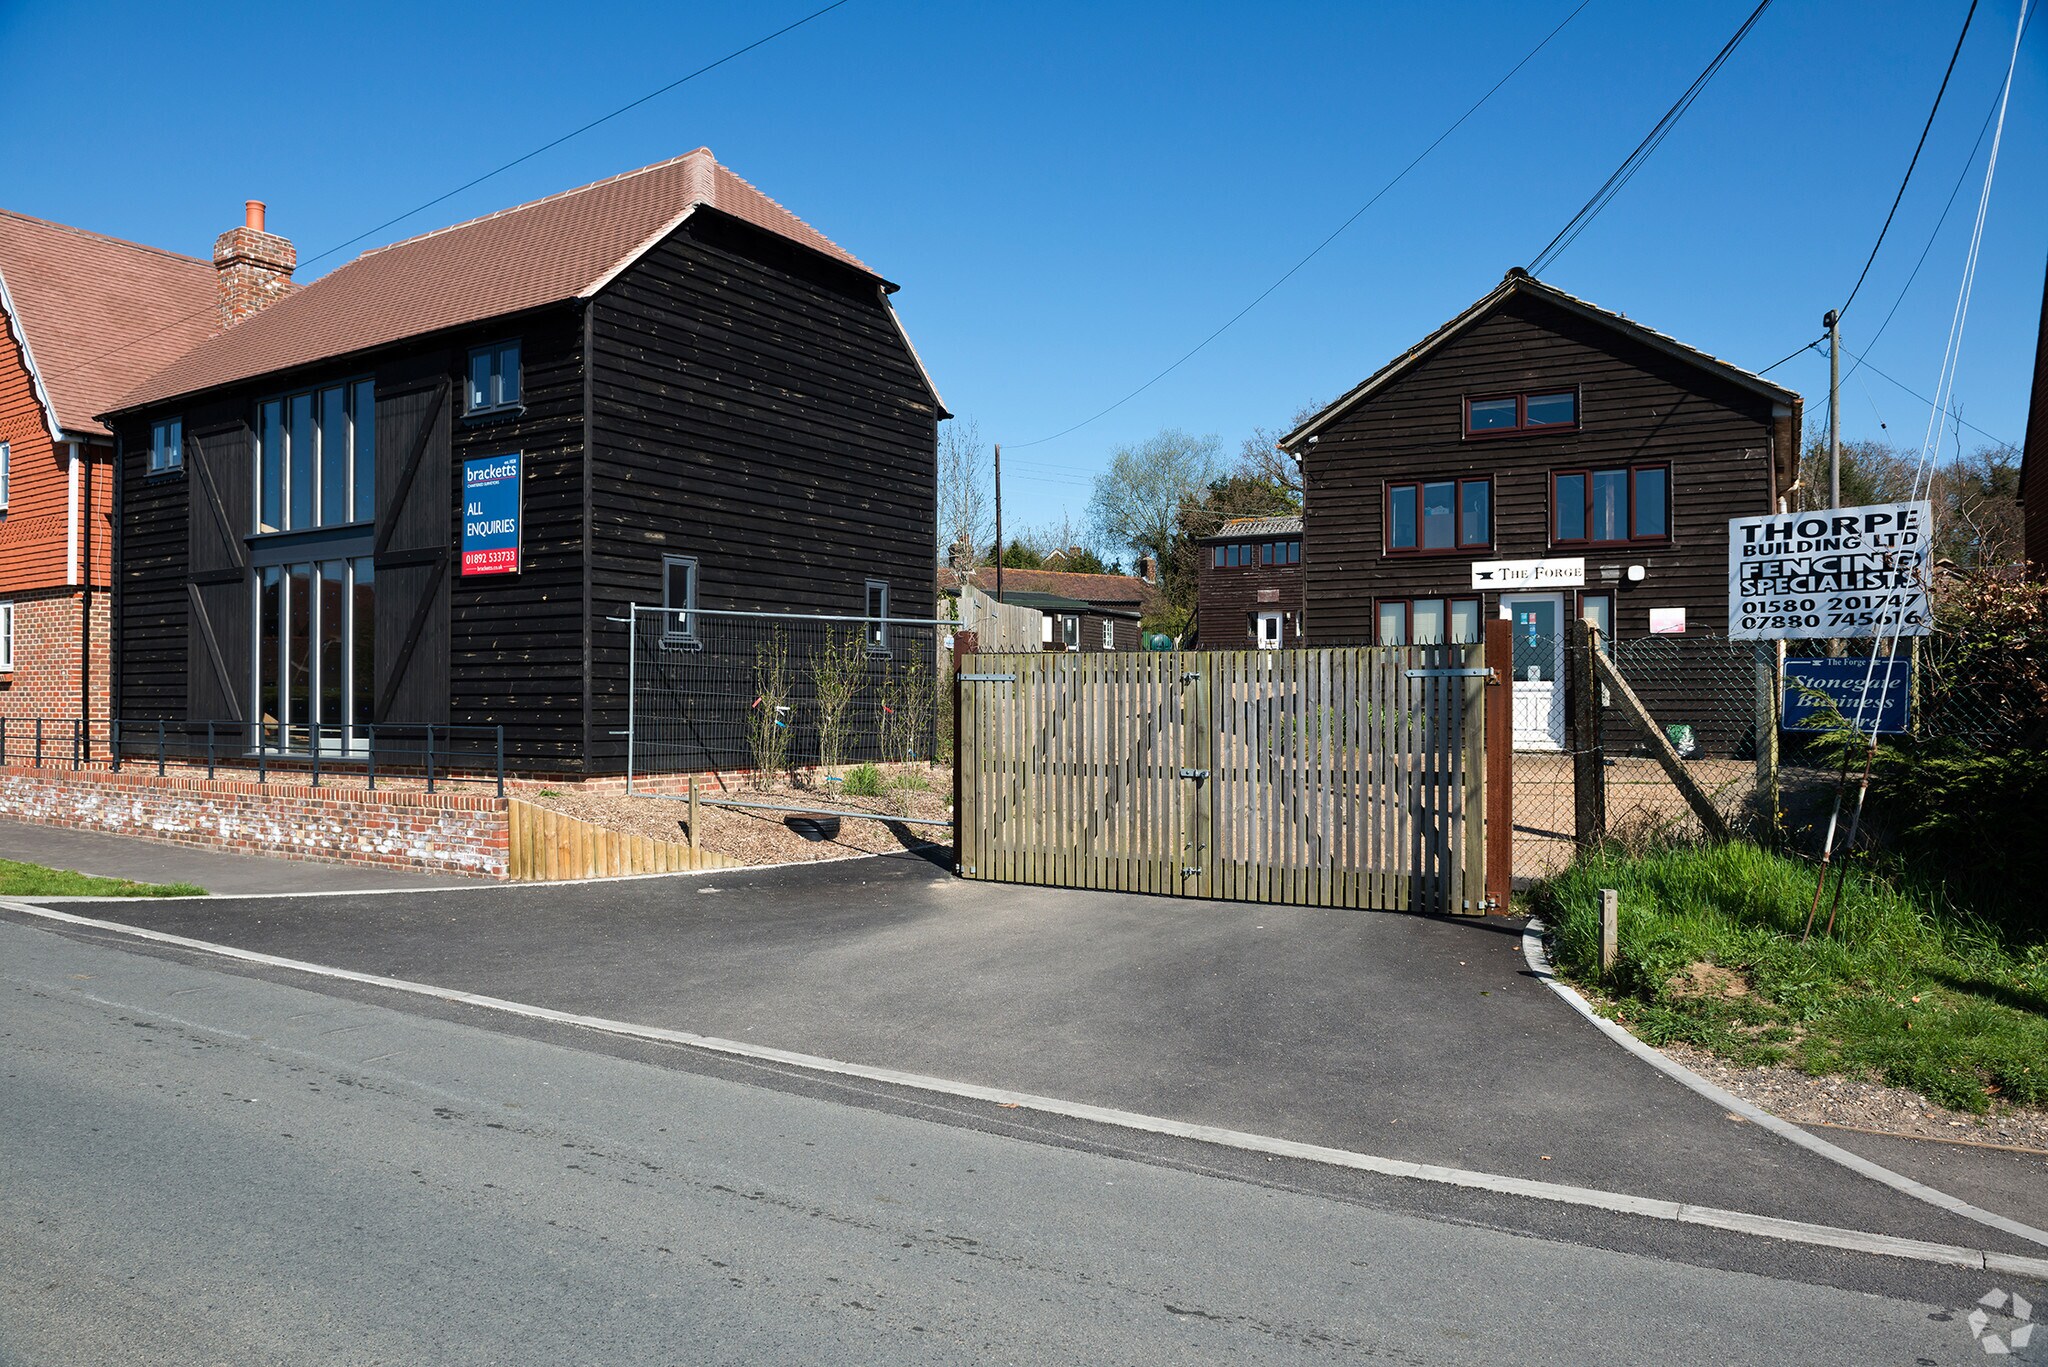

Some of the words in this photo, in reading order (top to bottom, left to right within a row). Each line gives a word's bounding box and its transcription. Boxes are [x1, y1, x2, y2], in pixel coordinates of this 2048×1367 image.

[467, 464, 516, 481] bracketts
[467, 502, 483, 516] ALL
[467, 518, 514, 538] ENQUIRIES
[1740, 510, 1918, 543] THORPE
[1743, 536, 1861, 557] BUILDING
[1873, 532, 1919, 548] LTD
[465, 553, 487, 565] 01892
[488, 550, 515, 563] 533733
[1740, 550, 1922, 580] FENCING
[1740, 570, 1921, 597] SPECIALISTS
[1742, 599, 1816, 614] 01580
[1828, 593, 1920, 611] 201747
[1741, 614, 1820, 630] 07880
[1828, 610, 1920, 627] 745616
[1827, 658, 1842, 666] The
[1843, 658, 1867, 668] Forge
